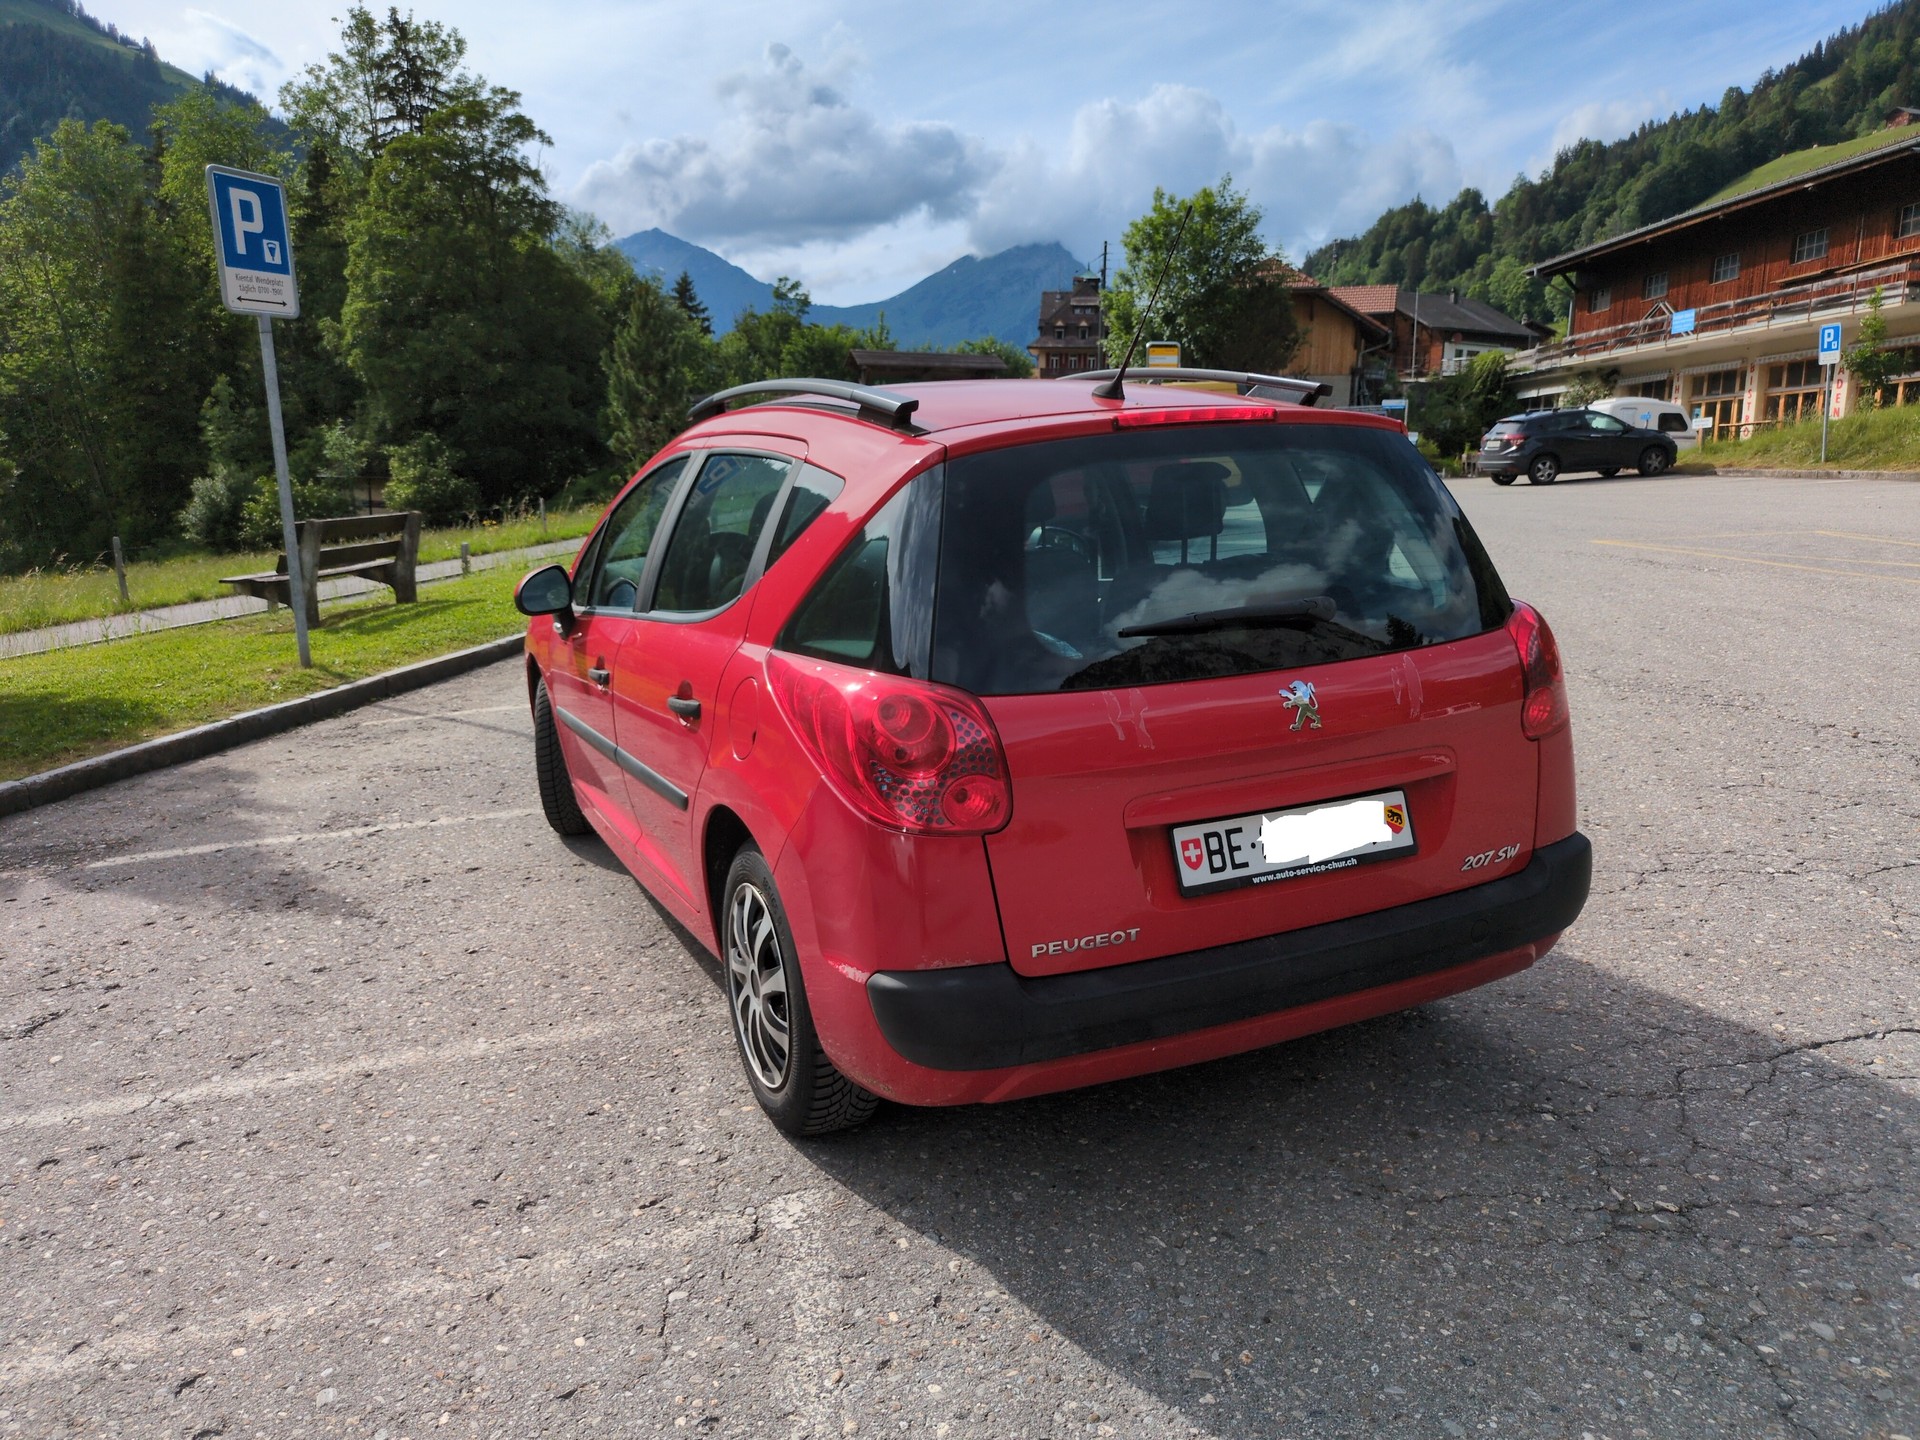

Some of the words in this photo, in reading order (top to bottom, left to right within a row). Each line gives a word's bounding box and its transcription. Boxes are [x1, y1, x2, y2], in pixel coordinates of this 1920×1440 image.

[228, 186, 264, 255] P
[1823, 328, 1834, 349] P
[1743, 362, 1756, 438] BISTRO
[1203, 827, 1250, 874] BE
[1461, 850, 1495, 871] 207
[1494, 843, 1520, 863] SW
[1252, 857, 1358, 884] www.auto-service-chur.ch
[1031, 927, 1141, 958] PEUGEOT
